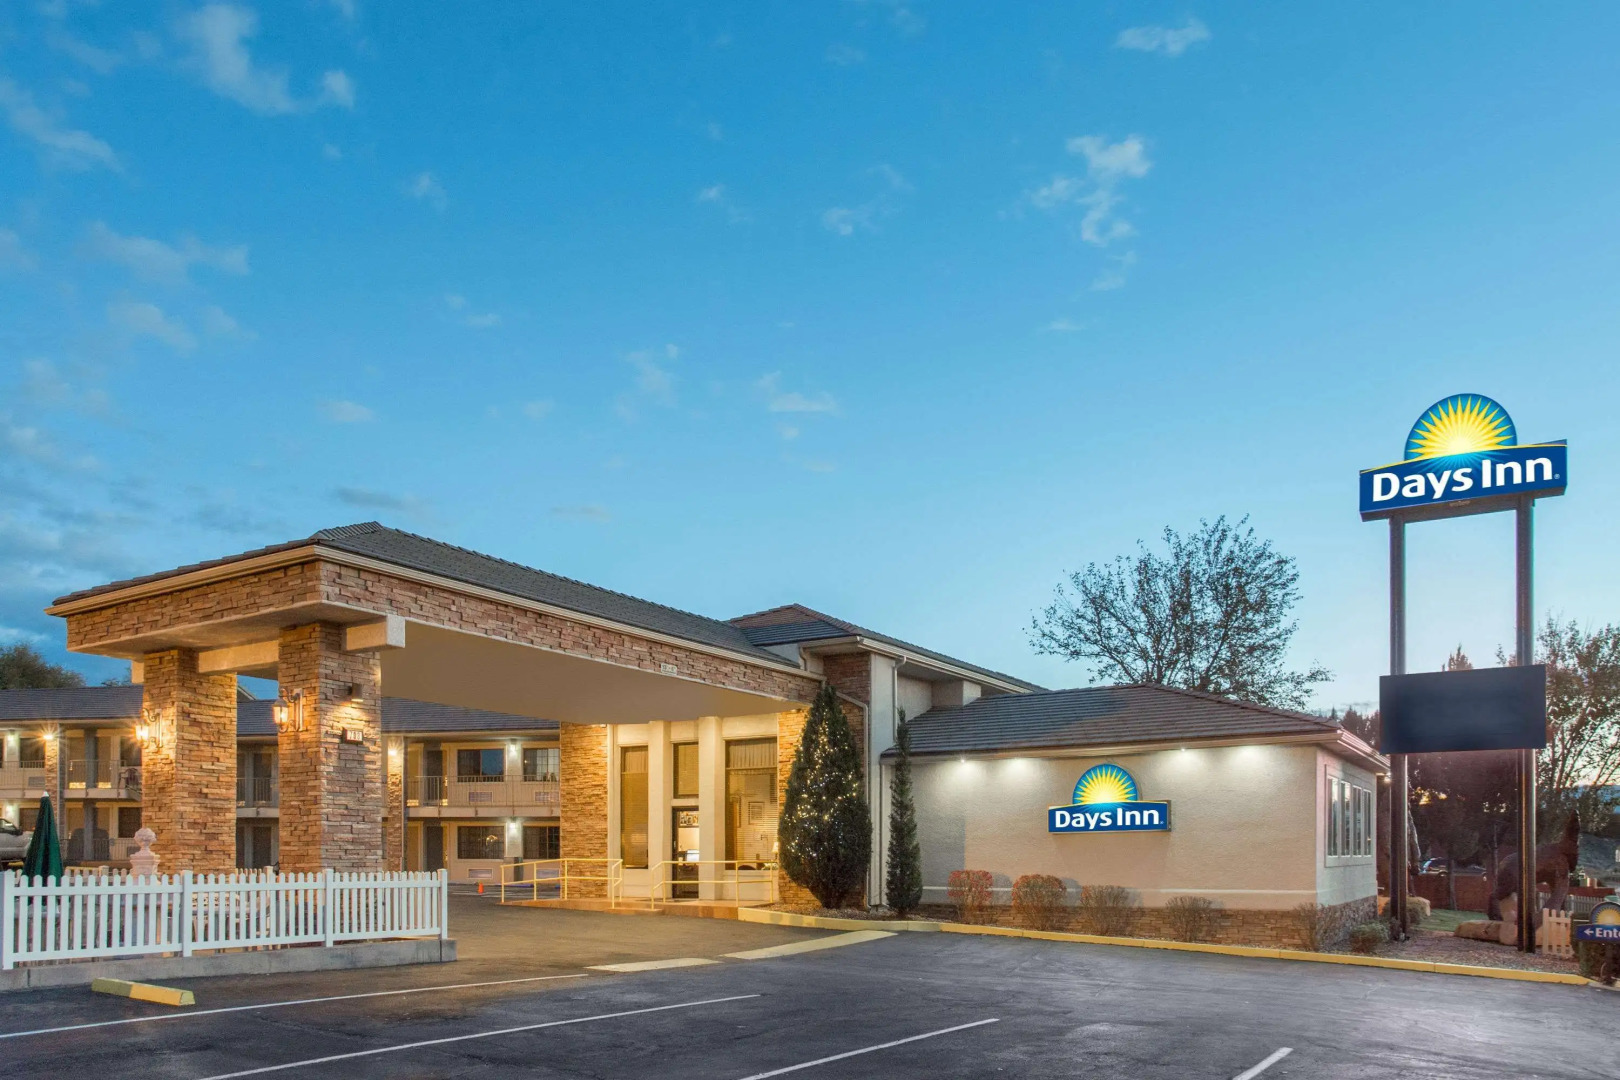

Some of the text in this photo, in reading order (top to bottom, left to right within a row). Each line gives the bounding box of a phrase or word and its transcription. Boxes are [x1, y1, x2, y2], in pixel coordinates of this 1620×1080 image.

[1373, 458, 1553, 502] Days Inn
[1055, 808, 1159, 829] Days Inn
